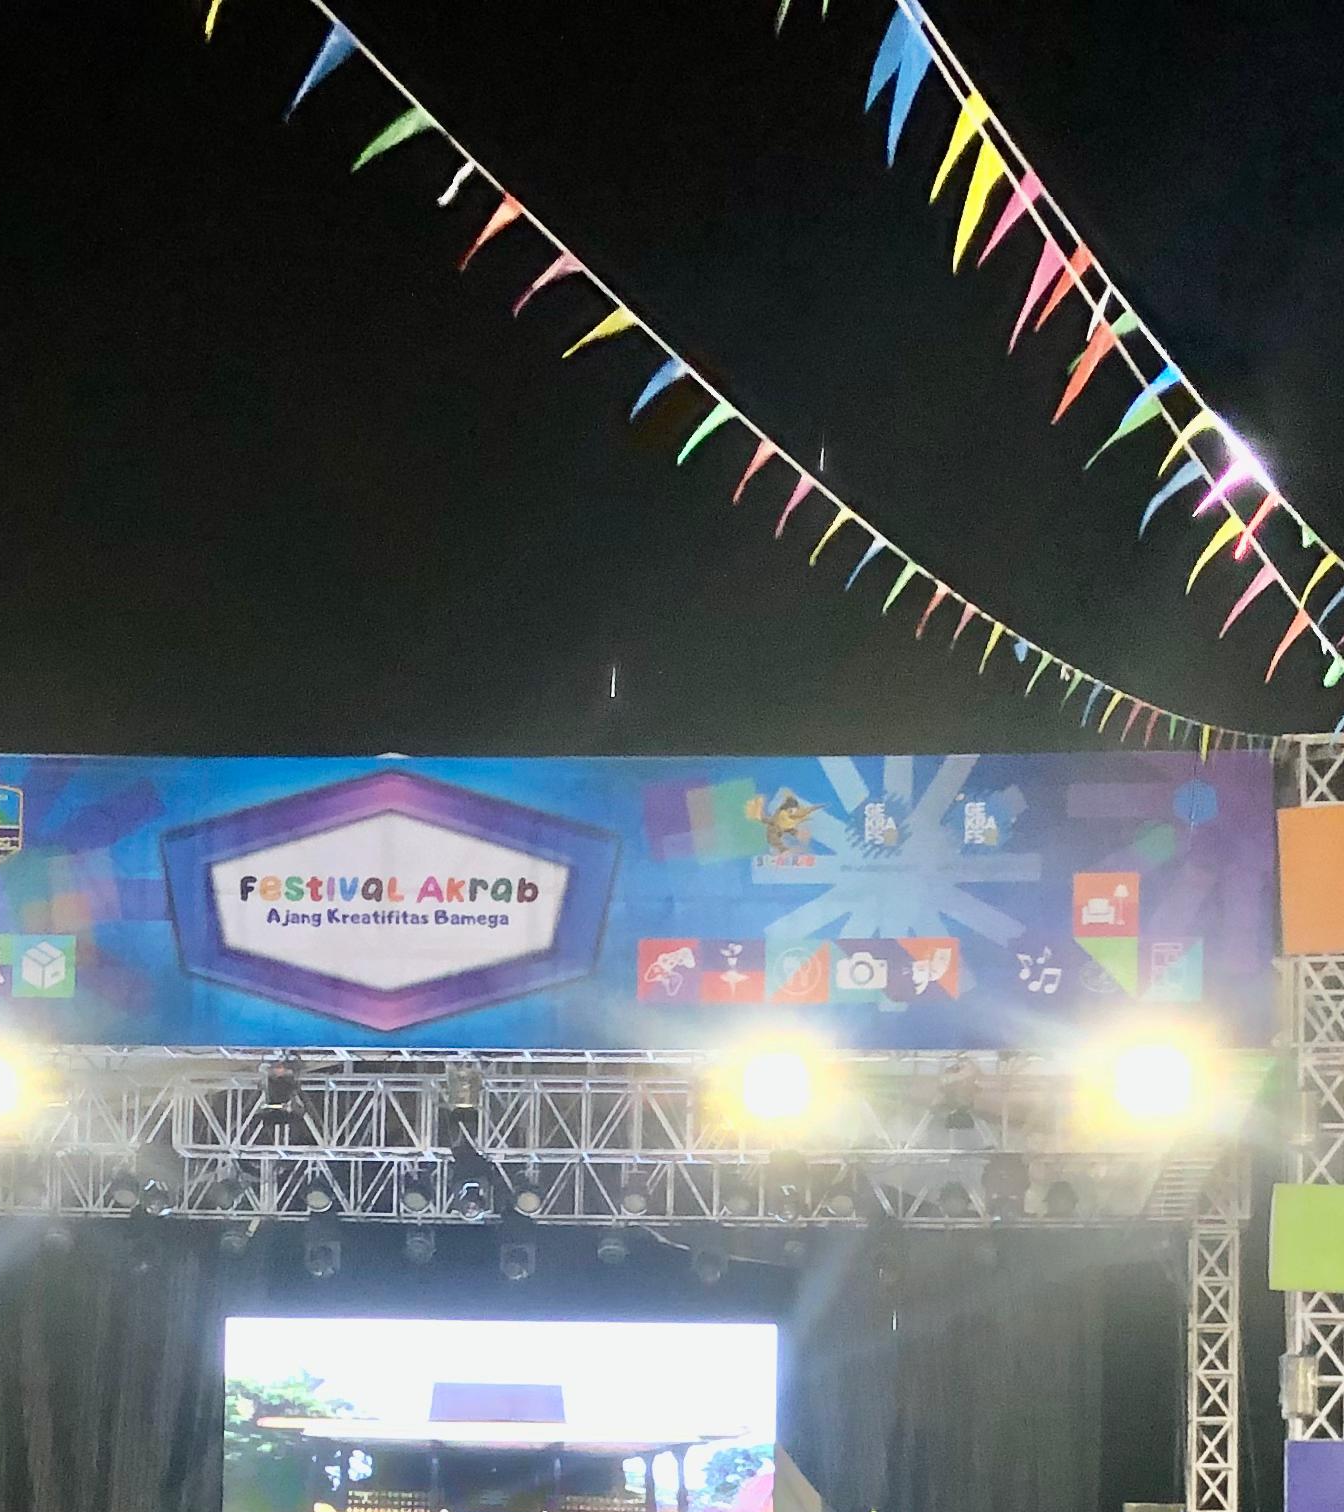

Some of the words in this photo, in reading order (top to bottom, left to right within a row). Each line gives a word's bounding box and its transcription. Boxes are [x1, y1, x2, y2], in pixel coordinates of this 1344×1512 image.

[416, 875, 540, 903] Akrab
[266, 908, 322, 927] Ajang
[327, 908, 430, 926] Kreatifitas
[434, 909, 510, 928] Bamega
